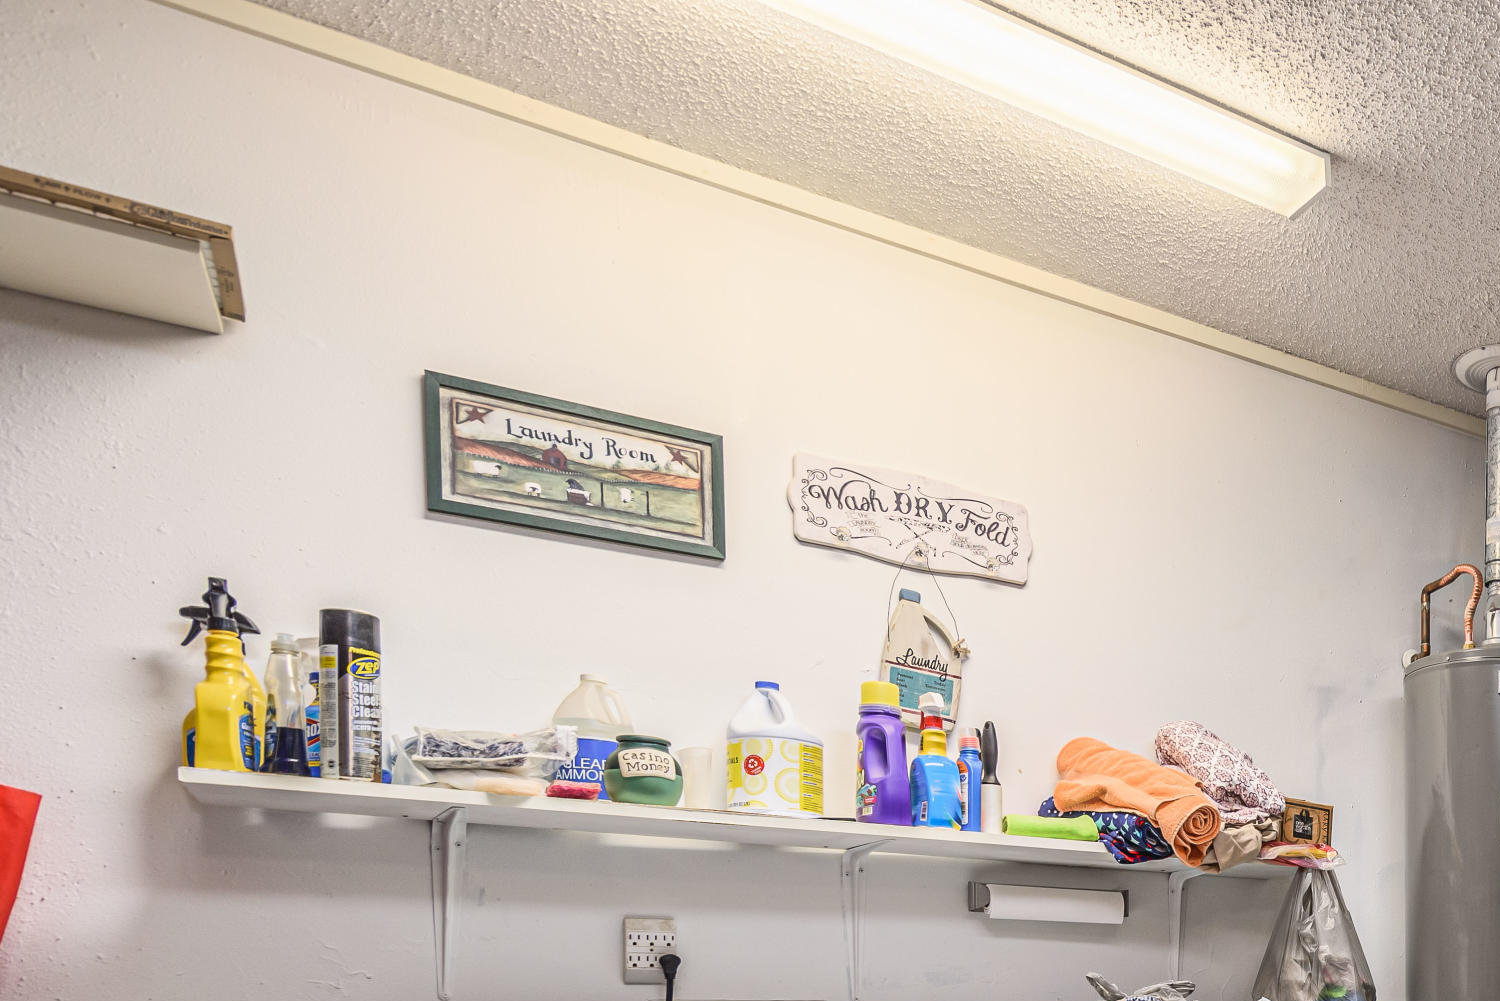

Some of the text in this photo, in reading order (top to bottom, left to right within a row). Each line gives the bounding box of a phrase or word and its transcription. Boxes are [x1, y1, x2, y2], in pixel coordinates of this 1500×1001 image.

[505, 418, 656, 463] Laundry Room
[808, 479, 888, 513] Wash
[893, 491, 955, 524] DRY
[955, 508, 1010, 547] Fold
[896, 648, 948, 682] Laundry
[626, 761, 670, 774] Money
